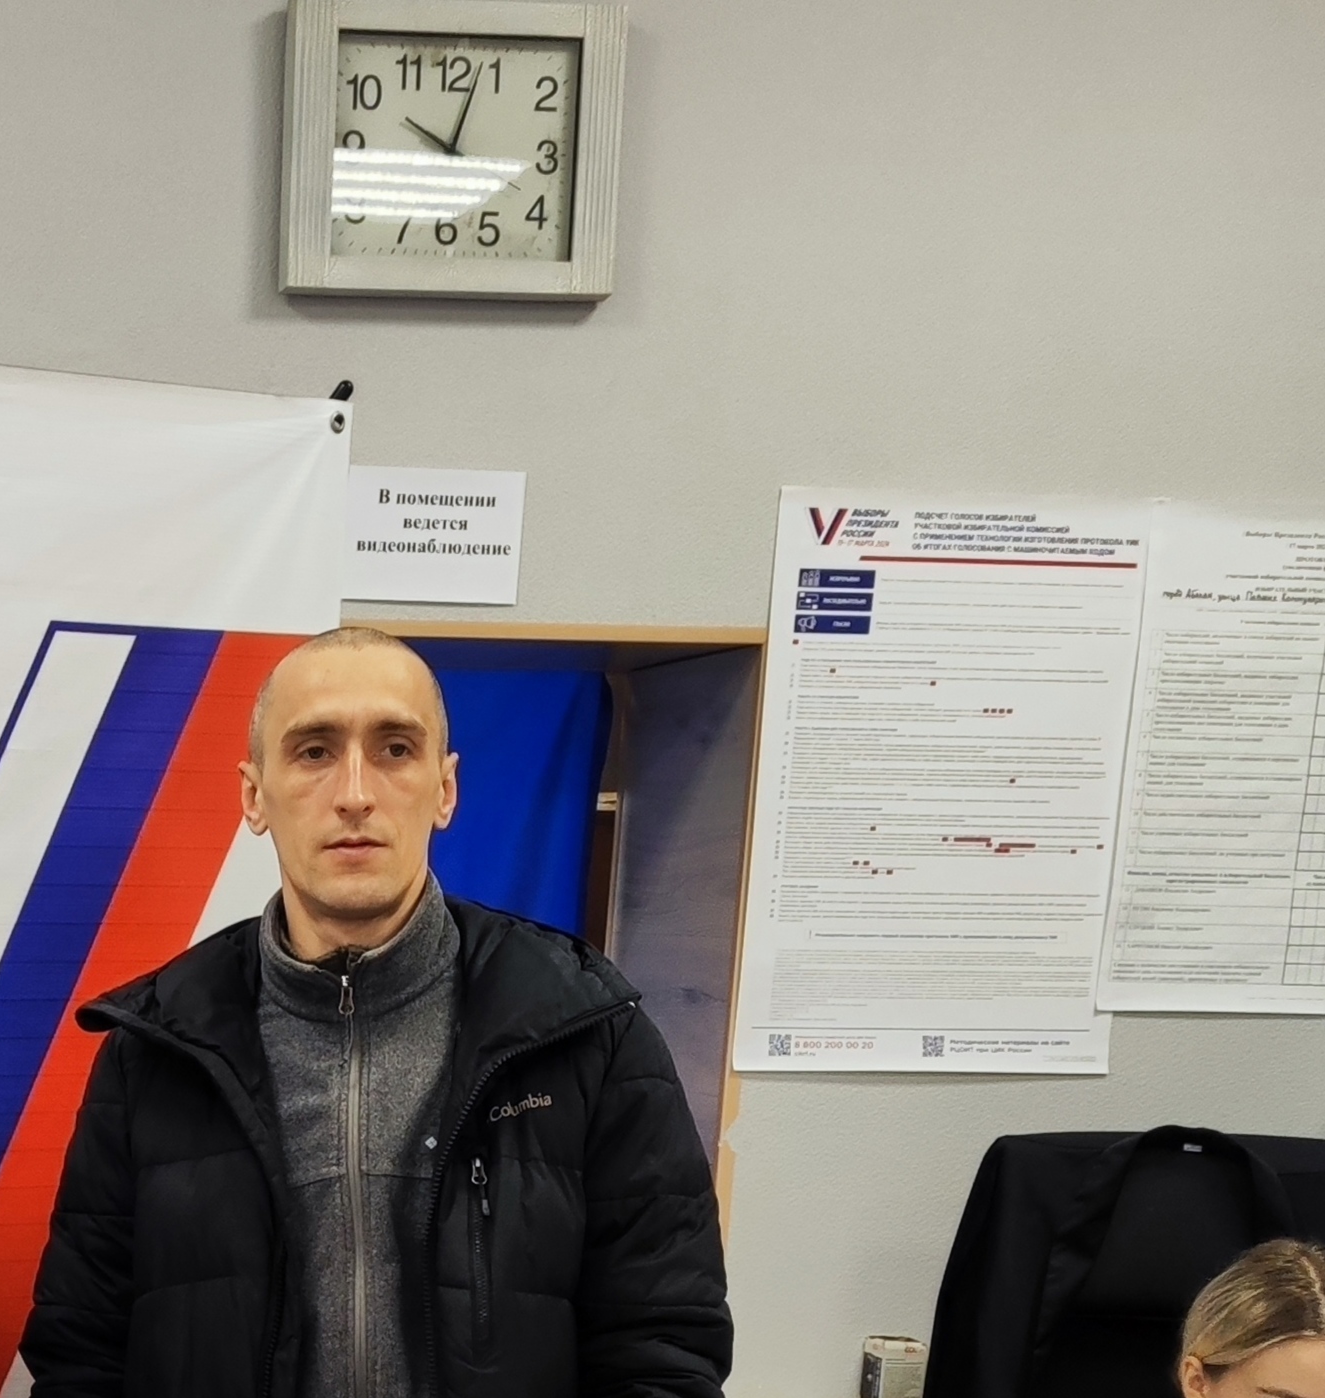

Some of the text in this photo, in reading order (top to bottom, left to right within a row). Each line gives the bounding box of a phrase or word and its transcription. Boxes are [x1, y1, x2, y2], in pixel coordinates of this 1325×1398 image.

[395, 54, 422, 91] 11
[436, 56, 472, 93] 12
[488, 57, 501, 94] 1
[347, 73, 383, 111] 10
[534, 75, 559, 112] 2
[535, 140, 559, 175] 3
[477, 211, 500, 247] 5
[525, 194, 549, 231] 4
[378, 488, 496, 508] В помещении
[403, 517, 468, 531] ведется
[356, 538, 512, 556] видеонаблюдение
[489, 1092, 553, 1122] Columbia
